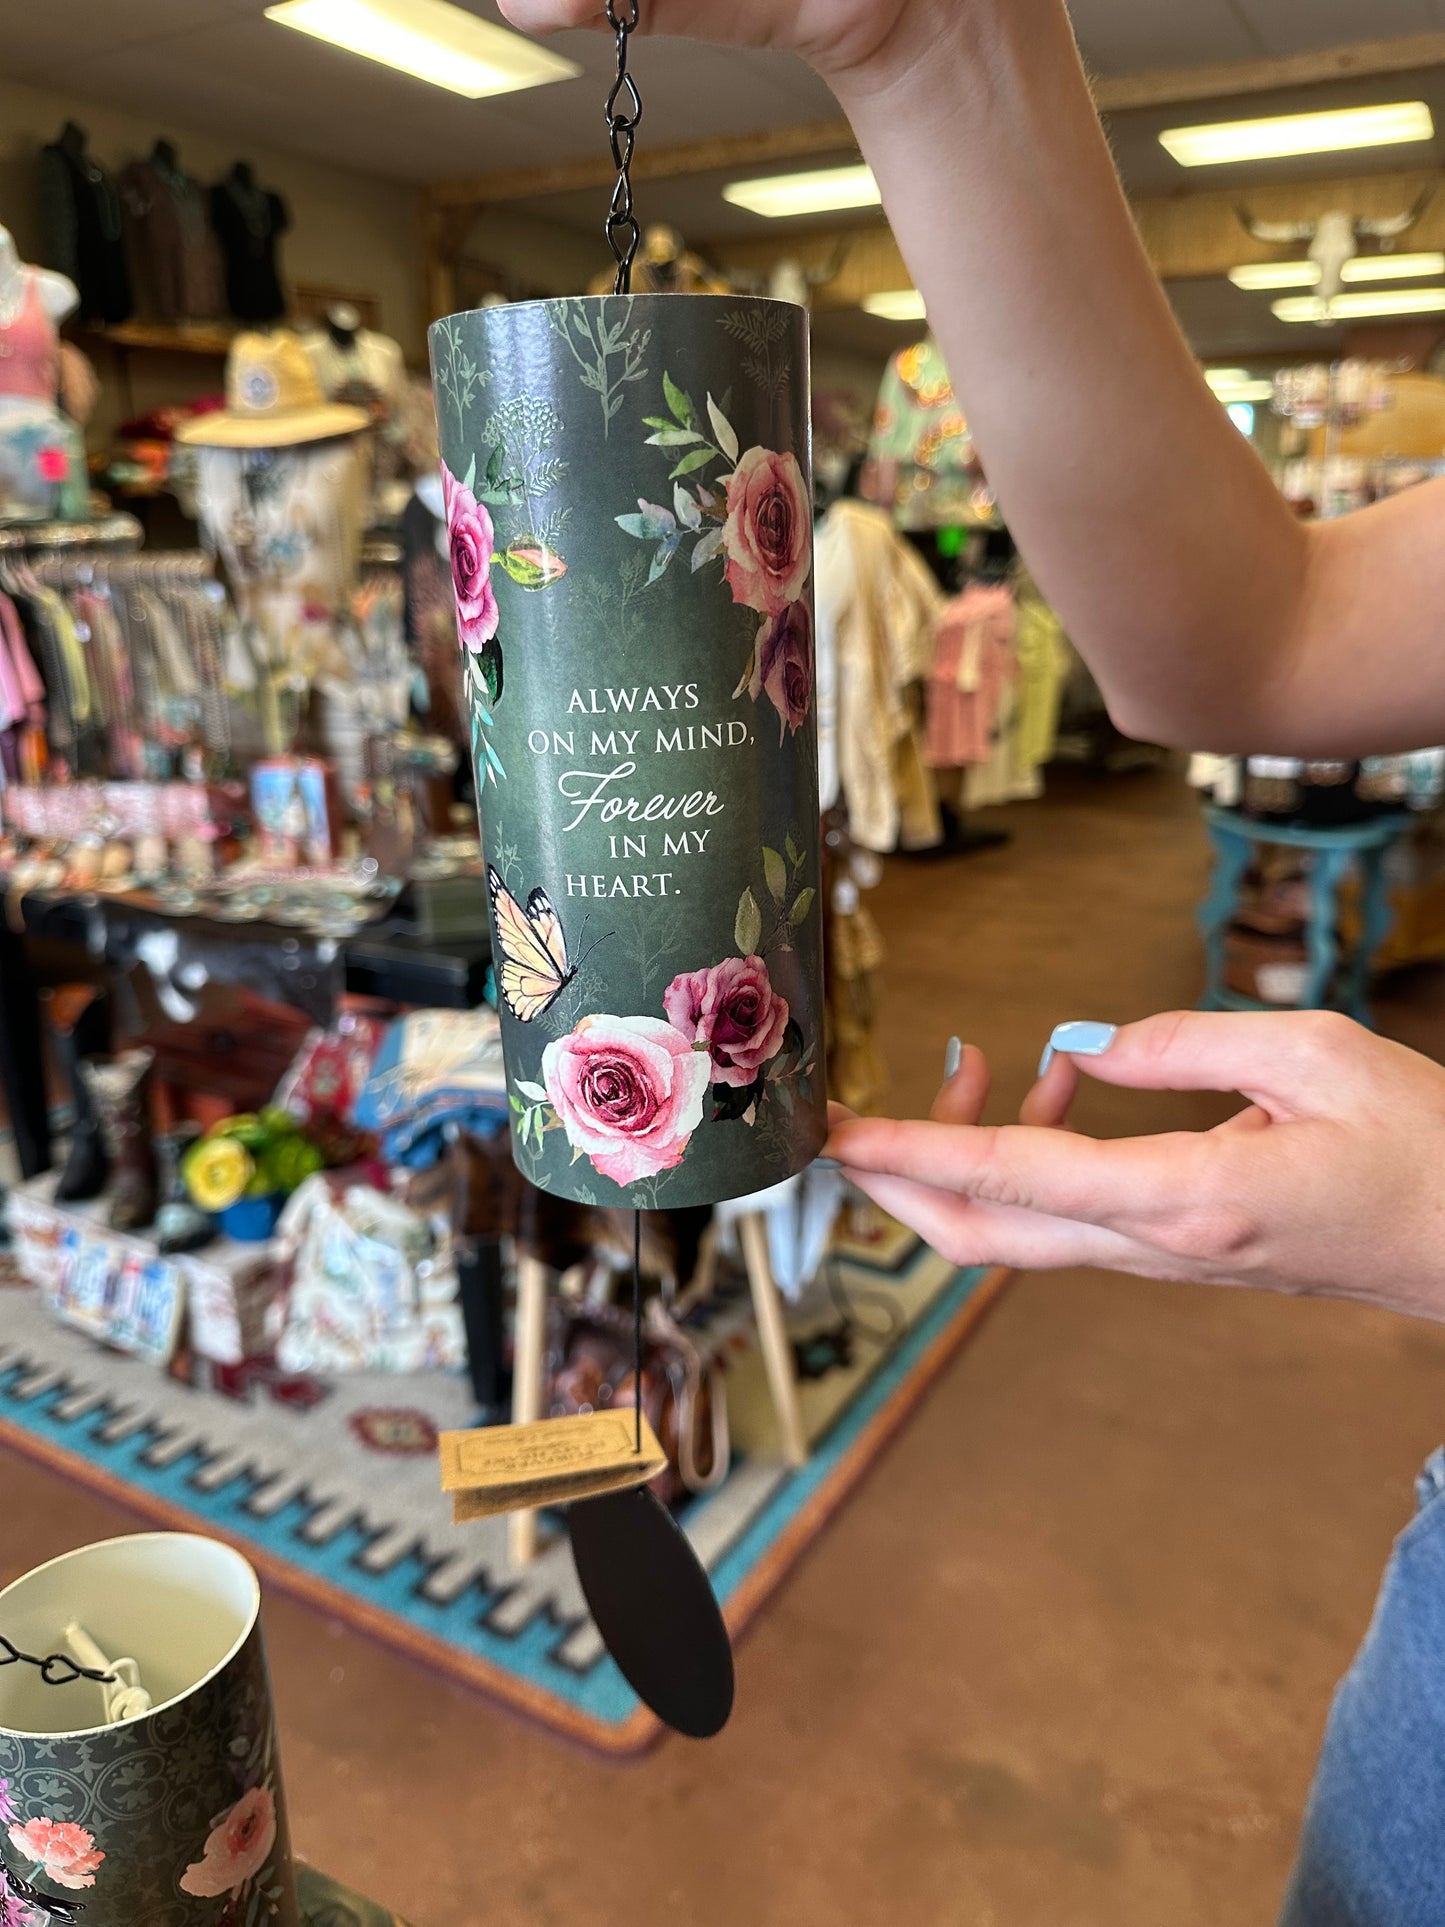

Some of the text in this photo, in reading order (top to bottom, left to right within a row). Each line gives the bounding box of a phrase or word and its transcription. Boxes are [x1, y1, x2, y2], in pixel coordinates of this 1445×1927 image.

[566, 683, 700, 714] ALWAYS
[528, 720, 755, 756] ON MY MIND,
[557, 761, 726, 832] Forever
[608, 828, 712, 859] IN MY
[564, 872, 681, 898] HEART.
